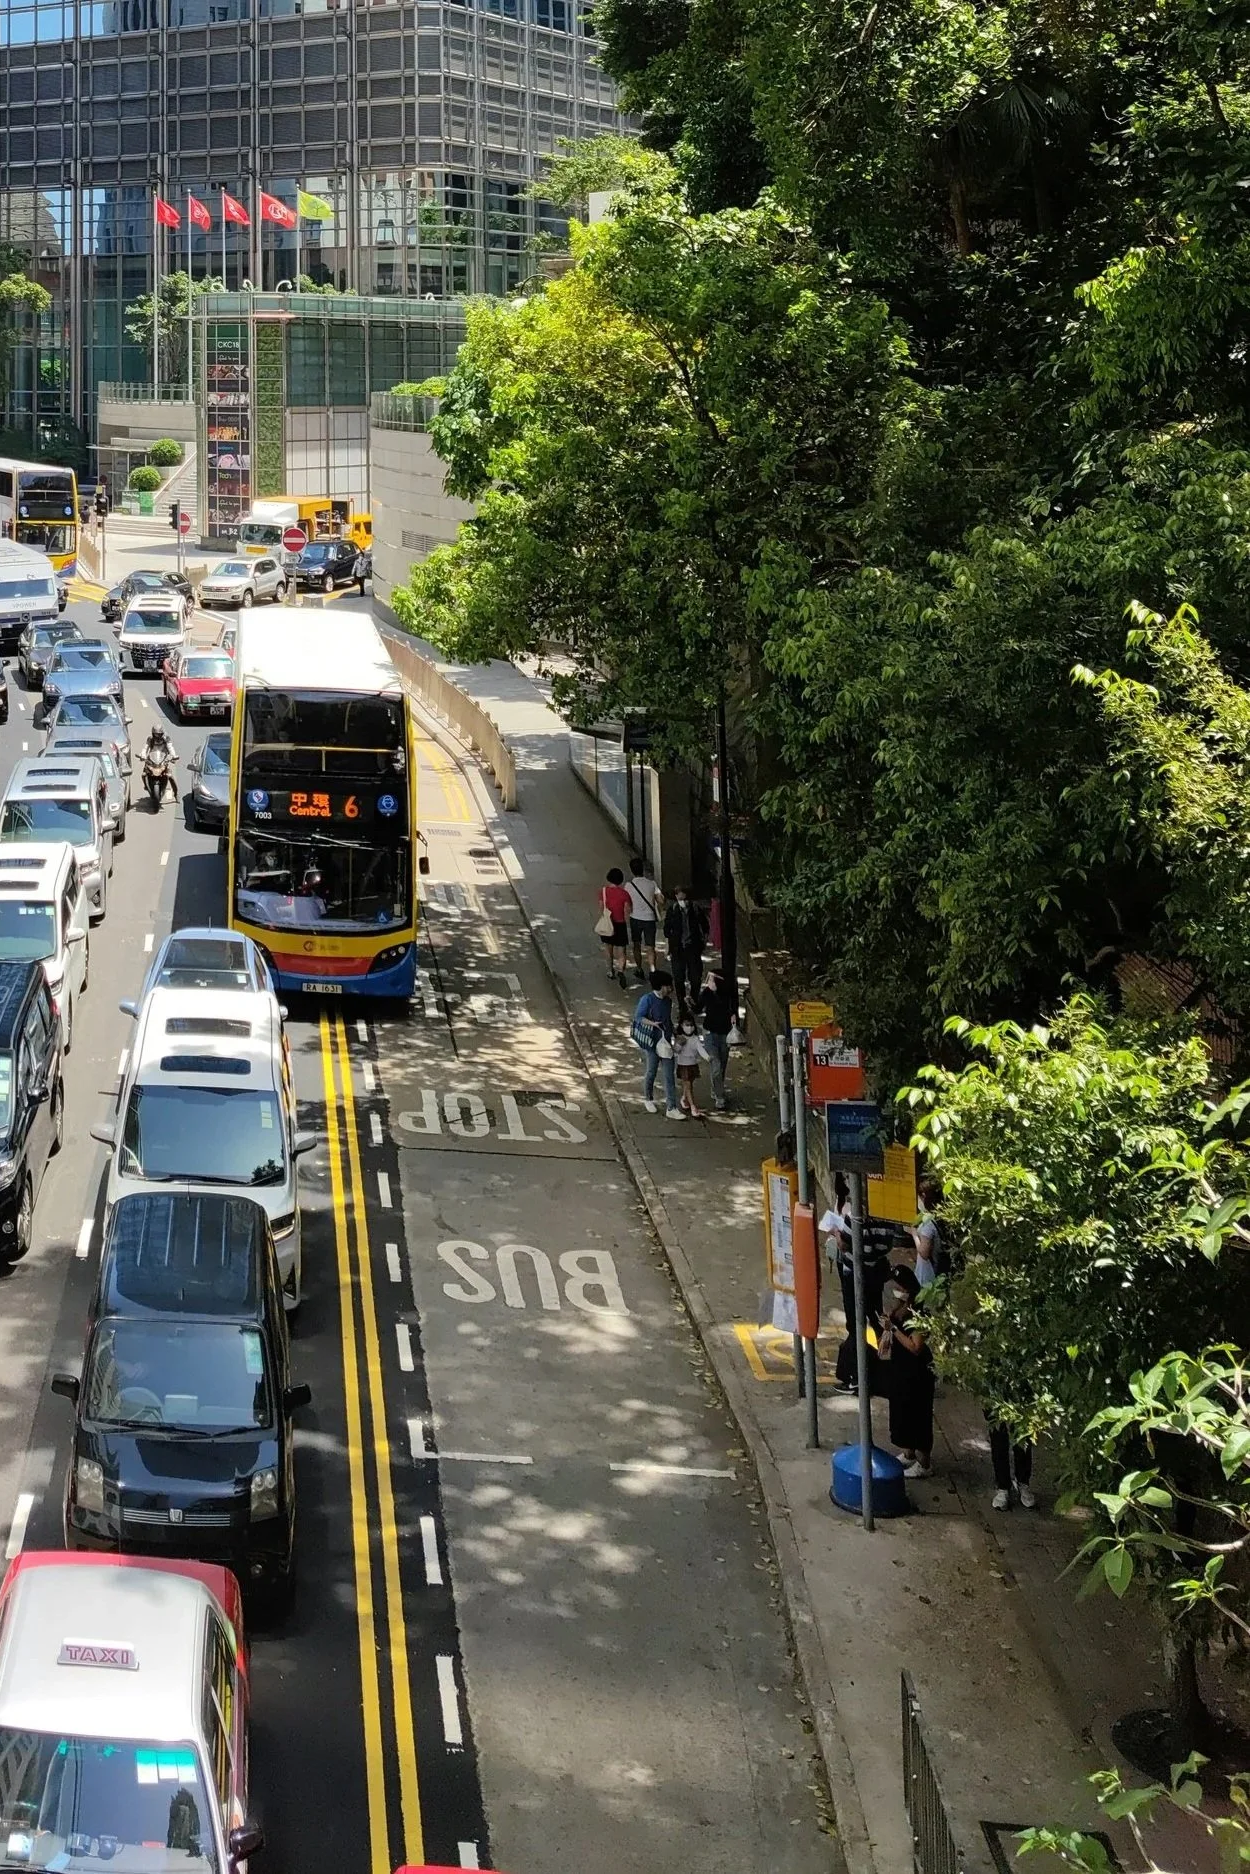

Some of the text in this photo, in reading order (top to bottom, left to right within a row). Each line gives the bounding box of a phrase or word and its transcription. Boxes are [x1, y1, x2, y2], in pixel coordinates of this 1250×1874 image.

[217, 340, 240, 349] CKC18
[291, 793, 330, 807] 中環
[289, 805, 332, 817] Central
[345, 796, 359, 818] 6
[254, 811, 273, 820] 7003
[306, 984, 339, 993] RA 1631
[815, 1055, 827, 1066] 13
[398, 1089, 588, 1144] STOP
[437, 1240, 630, 1316] BUS
[66, 1645, 129, 1665] TAXI
